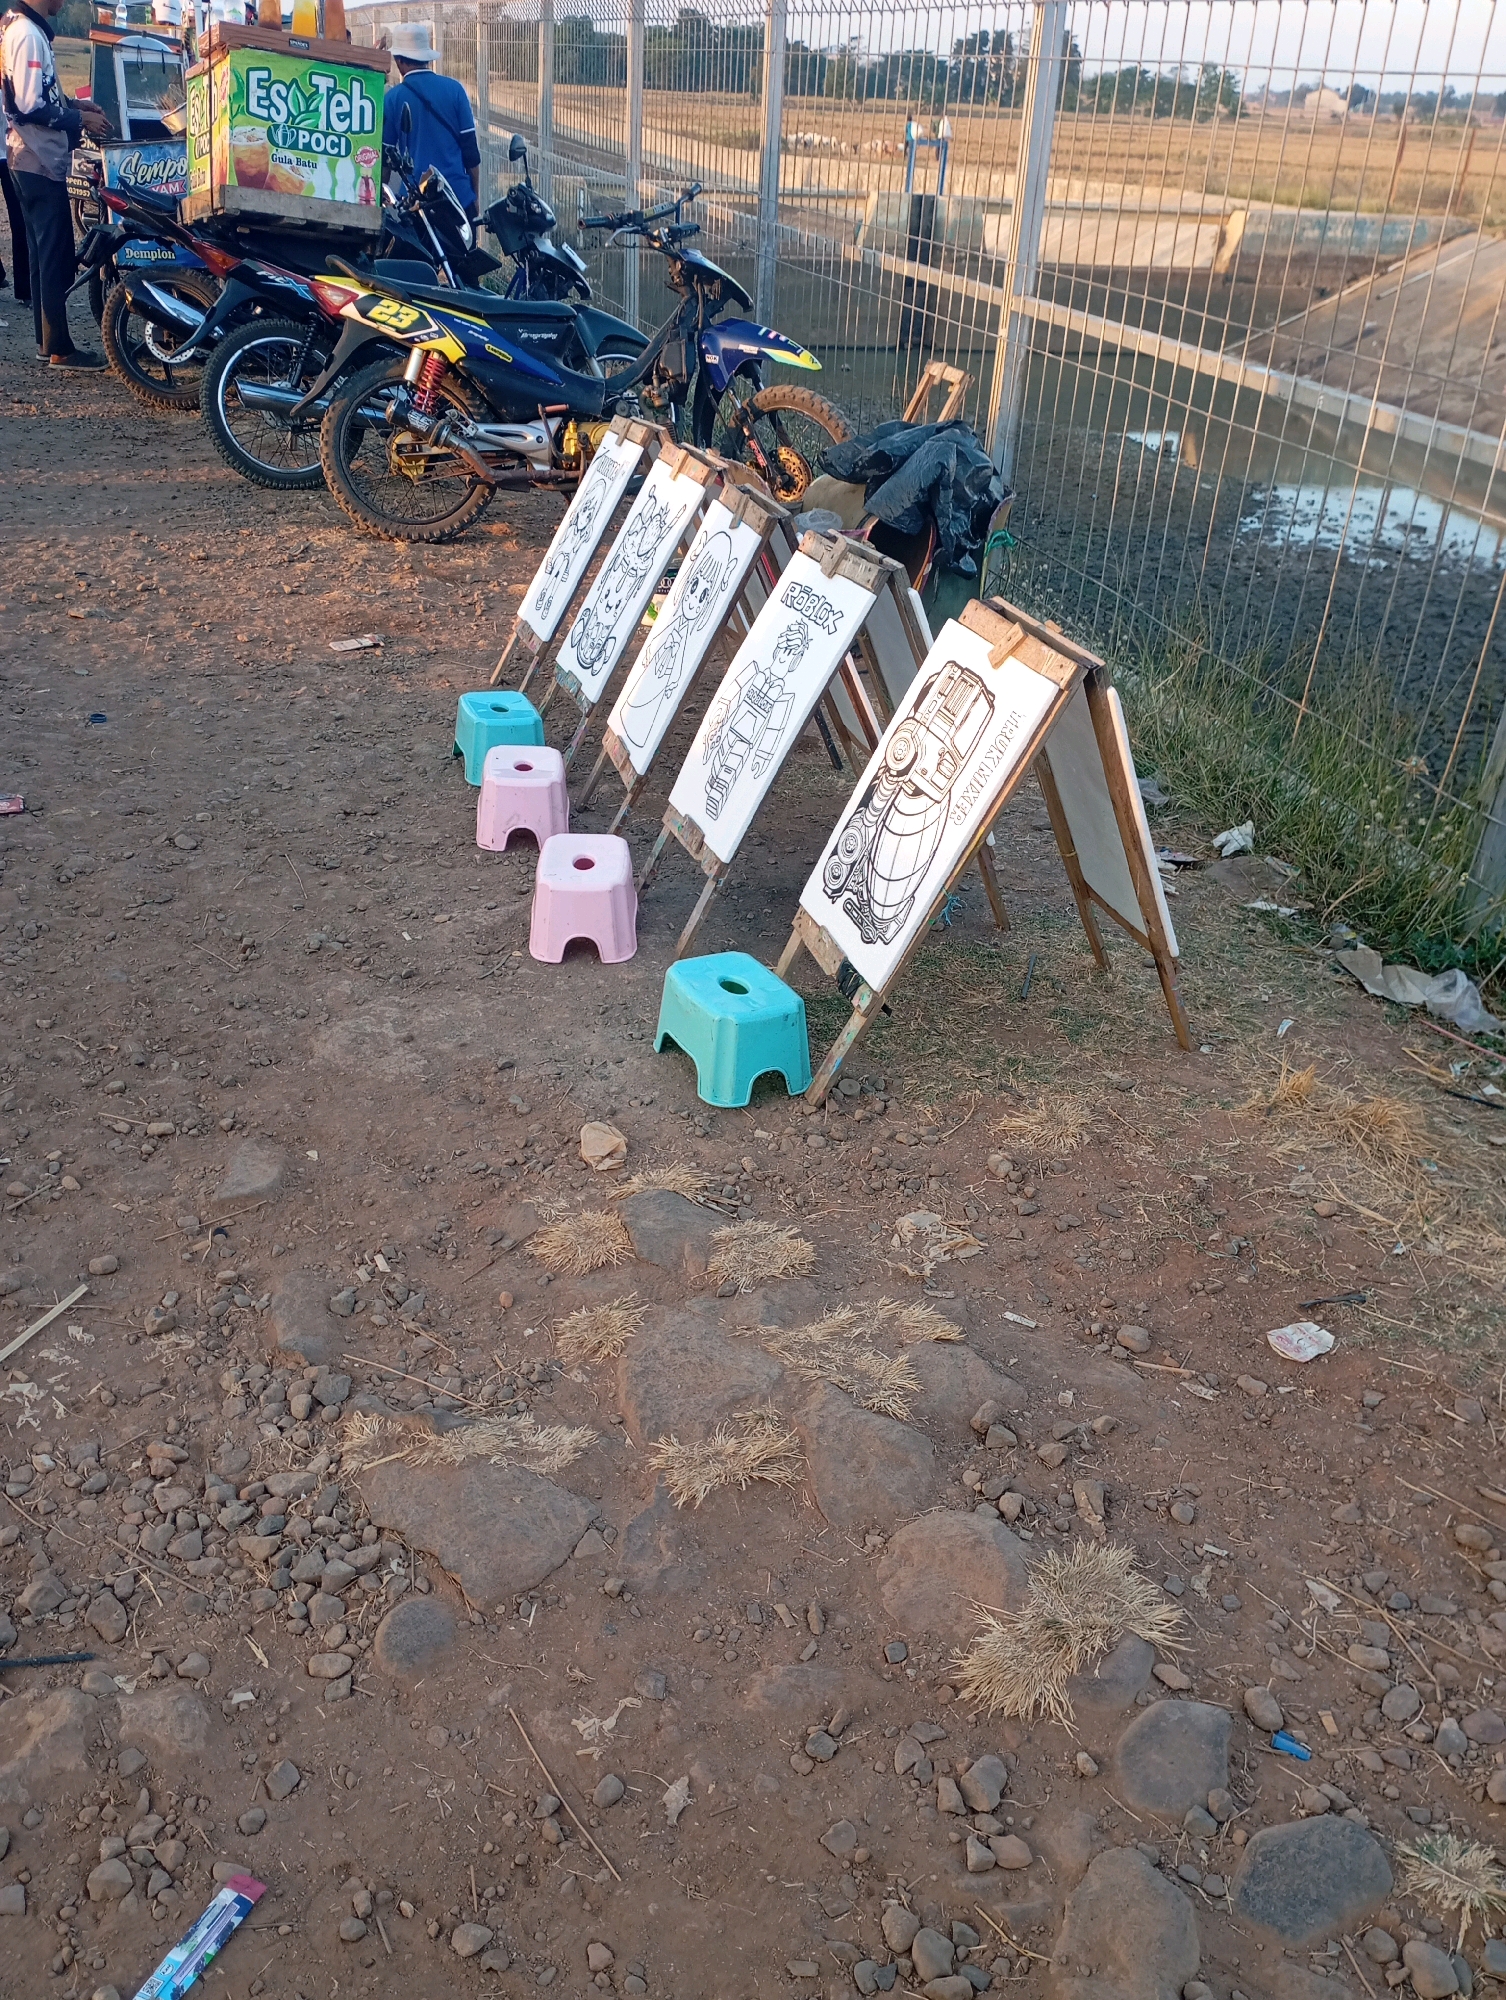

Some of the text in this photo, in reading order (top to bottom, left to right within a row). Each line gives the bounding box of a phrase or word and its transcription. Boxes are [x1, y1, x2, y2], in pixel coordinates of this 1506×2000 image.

[247, 67, 289, 125] Es
[309, 72, 374, 133] Teh
[298, 130, 346, 156] POCI
[119, 151, 188, 186] Sempo
[271, 153, 318, 169] Gula Batu
[150, 182, 180, 194] YAM
[367, 298, 419, 329] 23
